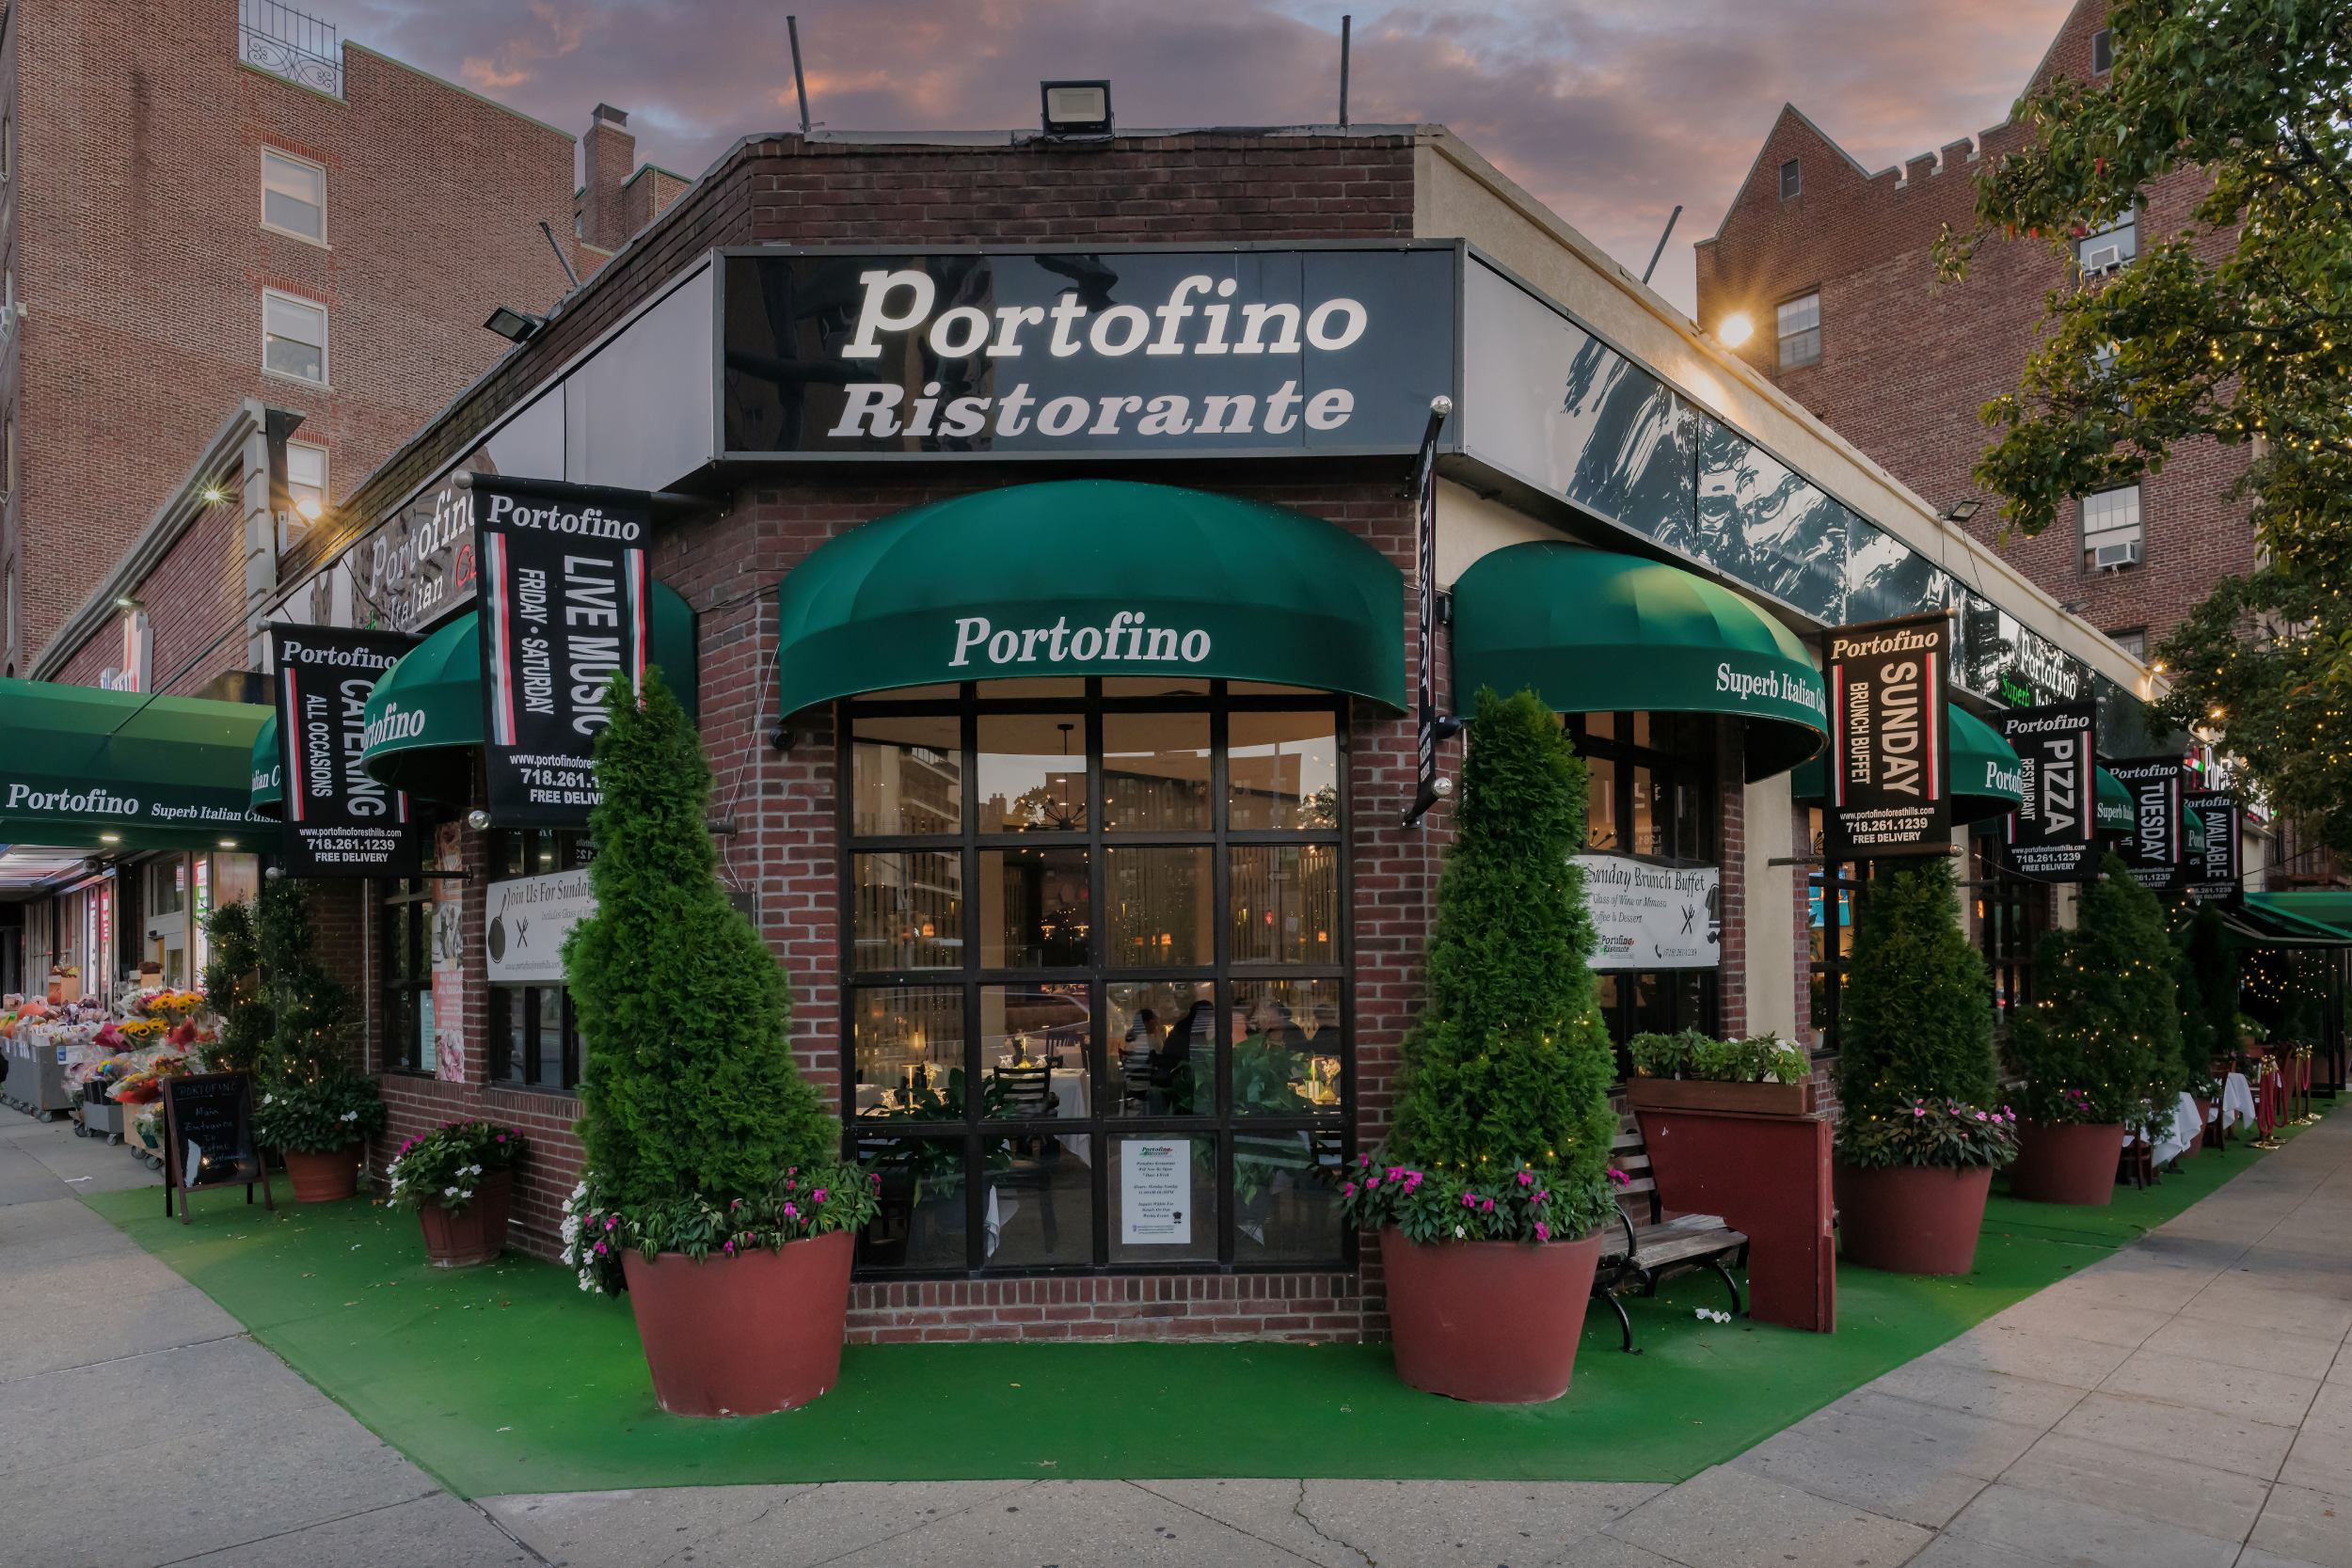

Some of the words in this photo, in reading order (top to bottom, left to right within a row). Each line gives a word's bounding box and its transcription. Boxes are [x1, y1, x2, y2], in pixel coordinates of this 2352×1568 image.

[841, 268, 1368, 359] Portofino
[827, 379, 1355, 438] Ristorante
[487, 494, 641, 541] Portofino
[389, 574, 444, 631] Italian
[518, 567, 548, 625] FRIDAY
[564, 555, 618, 627] LIVE
[947, 610, 1212, 667] Portofino
[1831, 629, 1939, 660] Portofino
[281, 641, 398, 670] Portofino
[2021, 631, 2076, 701] Portofino
[521, 637, 554, 715] SATURDAY
[567, 635, 621, 736] MUSIC
[1716, 662, 1779, 700] Superb
[1781, 673, 1816, 709] Italian
[2001, 674, 2030, 707] Superb
[306, 693, 327, 720] ALL
[1850, 682, 1869, 734] BRUNCH
[365, 702, 425, 750] ortofino
[1880, 661, 1920, 797] SUNDAY
[2005, 714, 2090, 735] Portofino
[308, 721, 333, 798] OCCASIONS
[509, 753, 602, 769] www.portofinofores
[1851, 735, 1870, 784] BUFFET
[2109, 764, 2178, 780] Portofino
[520, 768, 600, 789] 718.261.1
[1985, 761, 2023, 796] Portof
[2020, 758, 2036, 820] RESTAURANT
[2043, 738, 2075, 835] PIZZA
[6, 784, 139, 816] Portofino
[151, 802, 198, 821] Superb
[199, 805, 242, 821] Italian
[530, 788, 562, 803] FREE
[564, 791, 603, 805] DELIV
[2097, 802, 2122, 822] Superb
[2184, 796, 2237, 808] ortofin
[1840, 807, 1934, 821] www.portofinoforesthills.com
[1846, 817, 1928, 833] 718.261.1239
[2139, 782, 2166, 861] TUESDAY
[299, 827, 402, 837] www.portofinoforesthills.com
[307, 838, 395, 850] 718.261.1239
[1852, 833, 1875, 845] FREE
[1877, 832, 1921, 843] DELIVERY
[2205, 812, 2228, 878] AVAILABLE
[315, 852, 340, 862] FREE
[342, 852, 389, 863] DELIVERY
[2016, 852, 2081, 864] 718.261.1239
[2022, 863, 2041, 872] FREE
[2041, 863, 2075, 872] DELIVERY
[506, 887, 524, 911] Join
[526, 883, 537, 903] Us
[540, 881, 556, 902] For
[557, 876, 593, 903] Sunday
[1587, 863, 1631, 893] Sunday
[1634, 866, 1672, 890] Brunch
[1675, 871, 1706, 897] Buffet
[1591, 911, 1611, 924] Coffee
[1618, 913, 1643, 924] Dessert
[1593, 895, 1610, 905] Glass
[1611, 895, 1619, 908] of
[1619, 895, 1635, 906] Wine
[1635, 898, 1642, 907] or
[1644, 896, 1667, 908] Mimosa
